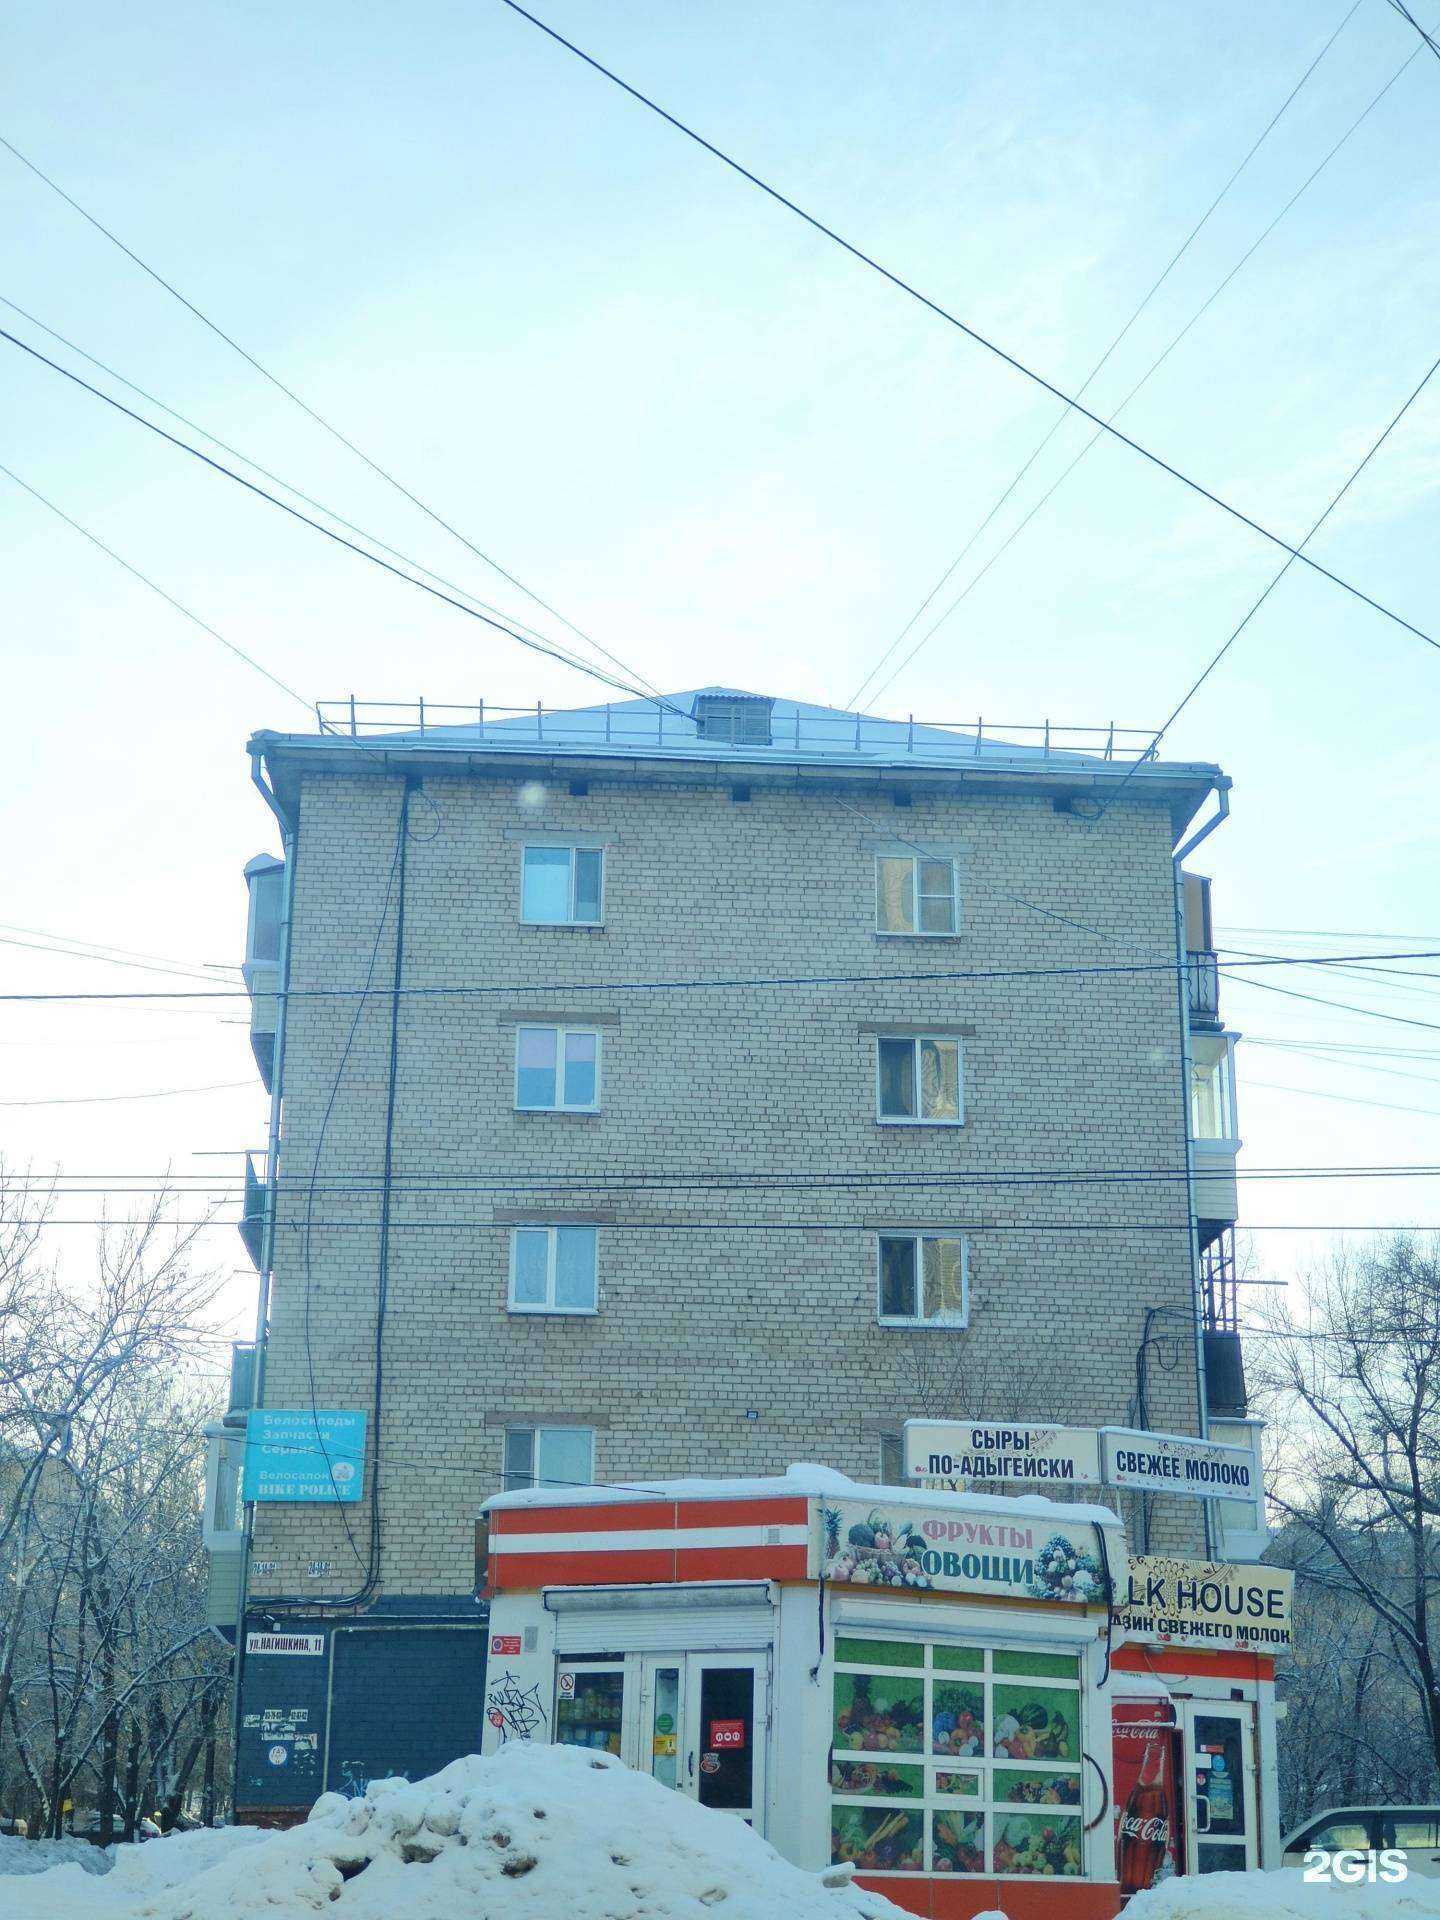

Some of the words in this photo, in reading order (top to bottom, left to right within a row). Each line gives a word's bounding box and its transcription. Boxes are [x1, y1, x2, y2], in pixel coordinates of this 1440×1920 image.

[263, 1414, 355, 1427] Велосипеды
[263, 1430, 331, 1440] Запчасти
[971, 1429, 1030, 1451] СЫРЫ
[260, 1471, 330, 1480] Велосалон
[928, 1453, 1074, 1478] ПО-АДЫГЕЙСКИ
[1116, 1450, 1181, 1478] СВЕЖЕЕ
[1185, 1458, 1250, 1487] МОЛОКО
[258, 1483, 296, 1496] BIKE
[300, 1484, 351, 1496] POLICE
[922, 1519, 1033, 1549] ФРУКТЫ
[921, 1550, 1034, 1586] ОВОЩИ
[1177, 1580, 1285, 1619] HOUSE
[1157, 1618, 1233, 1639] СВЕЖЕГО
[1236, 1626, 1291, 1644] МОЛОК
